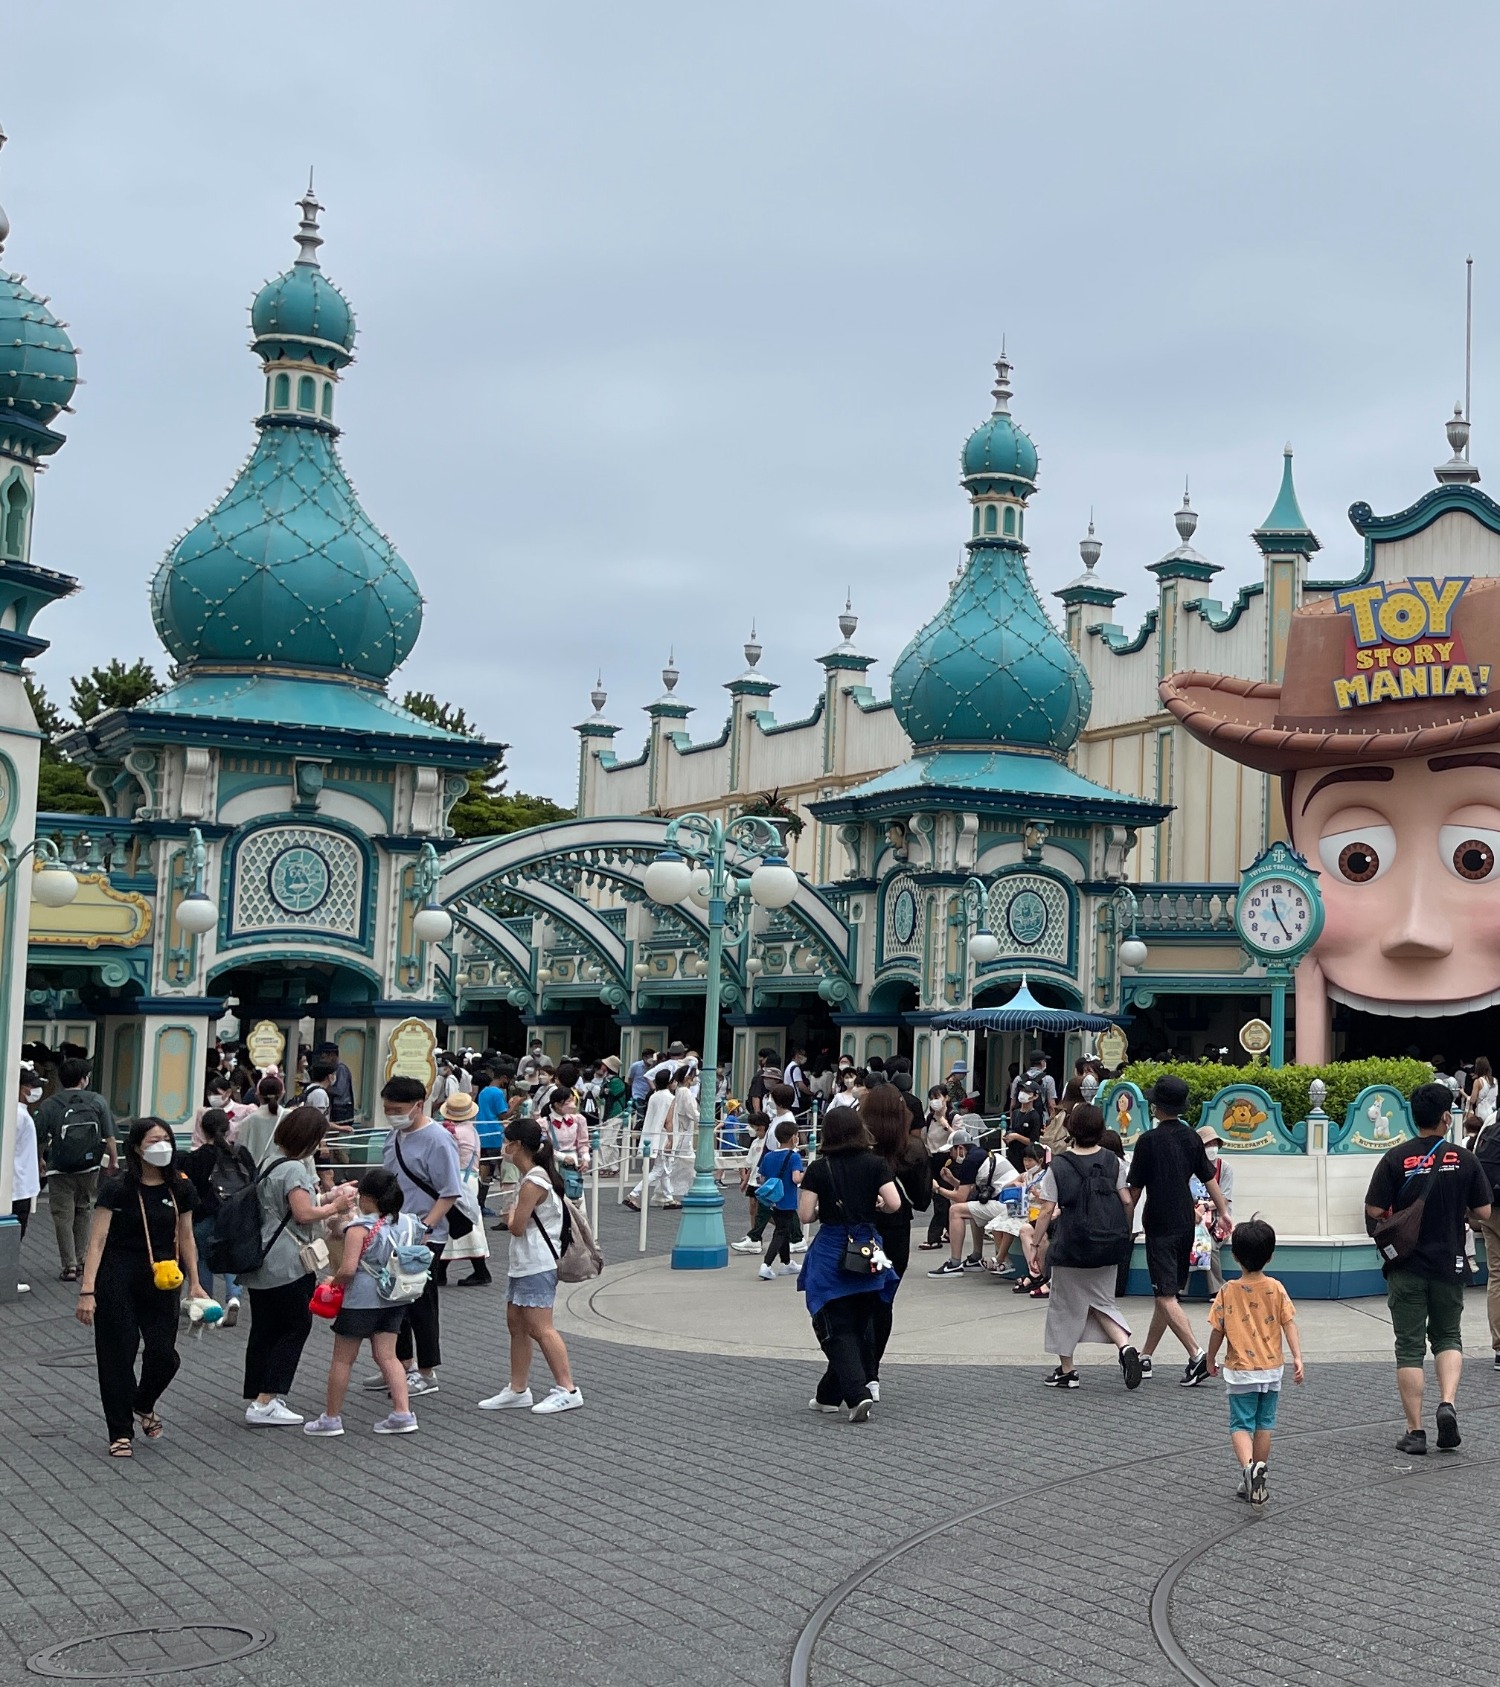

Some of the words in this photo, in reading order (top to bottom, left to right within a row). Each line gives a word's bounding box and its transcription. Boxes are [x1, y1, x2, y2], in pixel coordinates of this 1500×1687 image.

[1333, 577, 1471, 647] TOY
[1356, 642, 1454, 669] STORY
[1333, 664, 1492, 710] MANIA!
[1261, 888, 1269, 898] 11
[1272, 884, 1282, 894] 12
[1287, 888, 1292, 898] 1
[1251, 897, 1261, 907] 10
[1295, 897, 1303, 907] 2
[1248, 910, 1255, 919] 9
[1298, 910, 1305, 919] 3
[1251, 922, 1258, 932] 8
[1295, 922, 1302, 932] 4
[1260, 932, 1268, 941] 7
[1272, 935, 1280, 945] 6
[1358, 1137, 1402, 1148] BUTTERCUP
